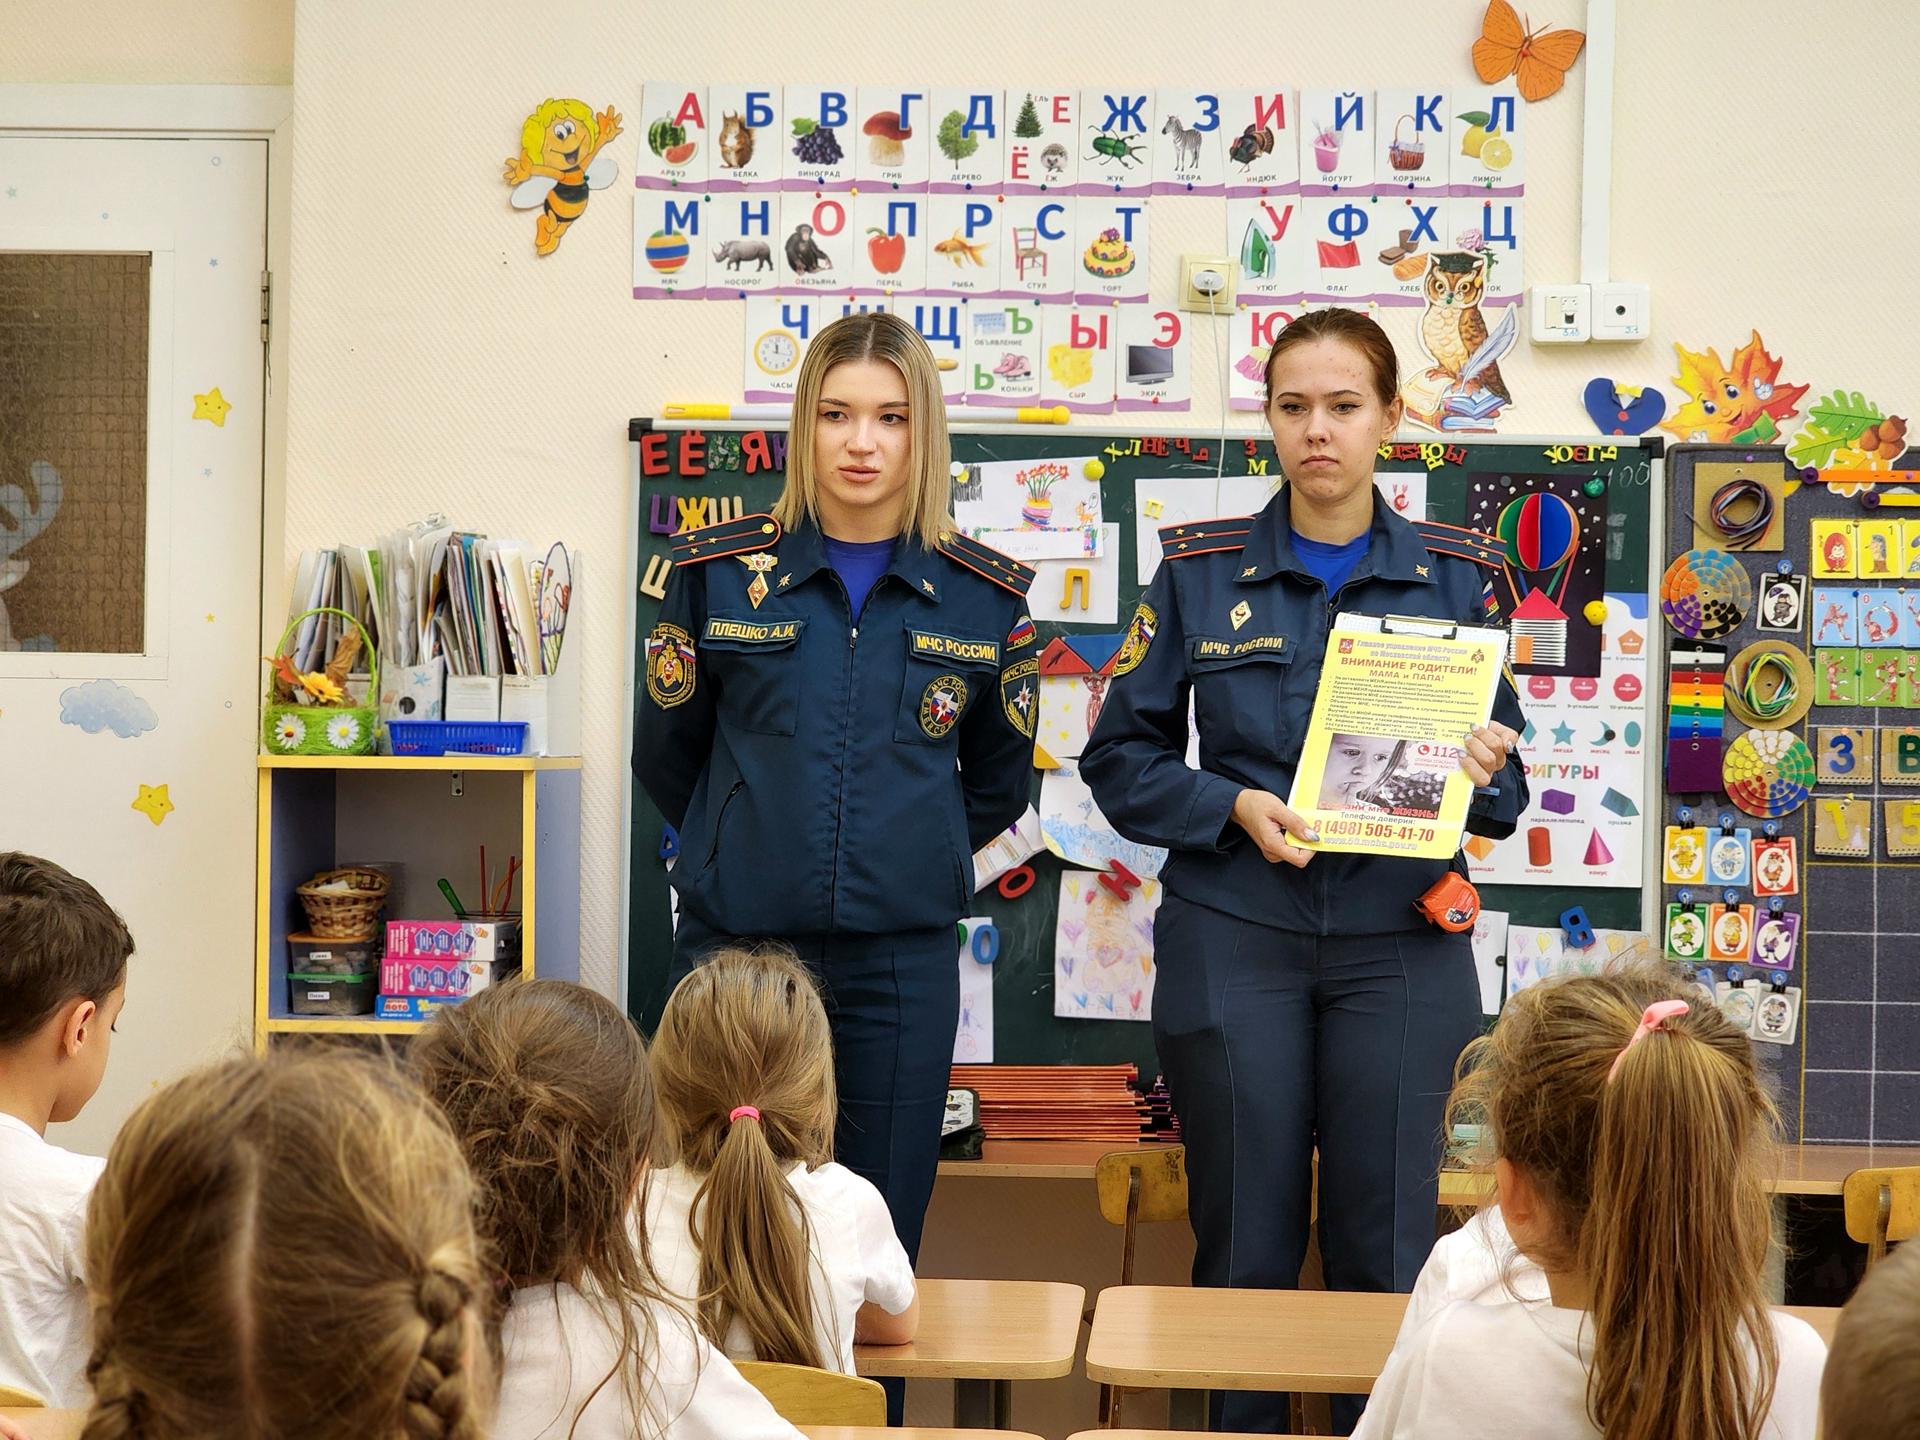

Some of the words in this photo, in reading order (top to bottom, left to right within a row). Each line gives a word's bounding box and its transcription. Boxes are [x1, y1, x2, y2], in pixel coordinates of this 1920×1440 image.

[673, 92, 704, 128] А
[746, 92, 773, 127] Б
[820, 92, 847, 127] В
[900, 94, 921, 129] Г
[961, 95, 995, 138] Д
[1053, 96, 1069, 123] Е
[1102, 95, 1147, 133] Ж
[1193, 95, 1220, 132] З
[1254, 94, 1285, 132] И
[1334, 91, 1364, 132] Й
[1415, 95, 1442, 132] К
[1486, 96, 1514, 132] Л
[1011, 145, 1030, 180] Ё
[664, 201, 698, 235] М
[741, 201, 769, 235] Н
[813, 200, 844, 235] О
[887, 202, 916, 236] П
[965, 203, 992, 238] Р
[1035, 204, 1064, 240] С
[1115, 207, 1141, 242] Т
[1265, 205, 1293, 241] У
[1327, 204, 1368, 241] Ф
[1410, 206, 1437, 241] Х
[1483, 206, 1516, 249] Ц
[782, 305, 808, 339] Ч
[915, 306, 960, 349] Щ
[1004, 307, 1034, 335] Ъ
[1070, 314, 1107, 349] Ы
[1152, 311, 1181, 348] Э
[1251, 311, 1295, 347] Ю
[974, 363, 995, 391] Ь
[710, 622, 768, 640] ПЛЕШКО
[916, 635, 944, 652] МЧС
[946, 639, 995, 661] РОССИИ
[1200, 641, 1230, 655] МЧС
[1233, 637, 1283, 654] РОССИИ
[1341, 657, 1407, 670] ВНИМАНИЕ
[1410, 662, 1478, 676] РОДИТЕЛИ!
[1369, 670, 1400, 679] МАМА
[1413, 673, 1445, 682] ПАПА!
[1431, 745, 1459, 758] 112
[1341, 812, 1376, 821] Телефон
[1377, 816, 1416, 825] доверия:
[1365, 823, 1435, 842] 505-41-70
